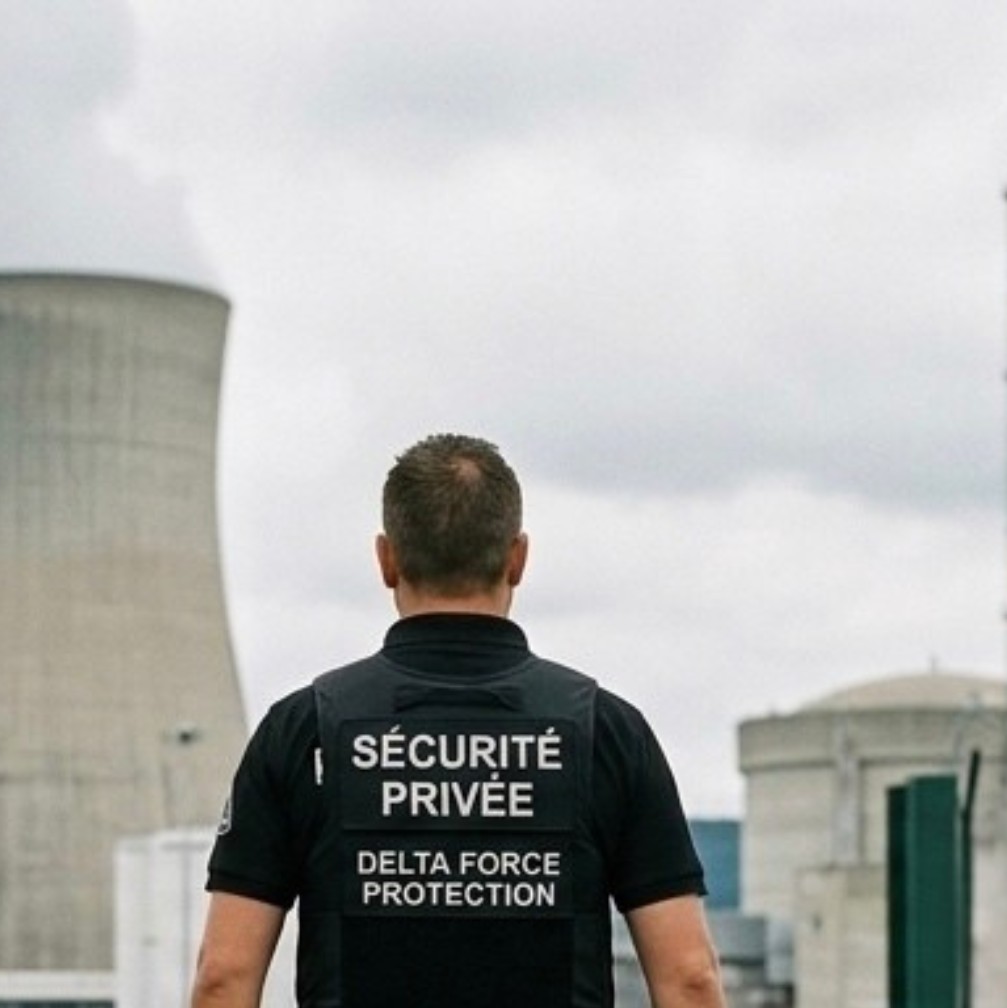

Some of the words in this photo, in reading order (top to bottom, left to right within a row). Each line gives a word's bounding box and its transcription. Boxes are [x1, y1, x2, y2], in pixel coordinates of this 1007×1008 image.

[351, 724, 563, 770] SÉCURITÉ
[382, 771, 534, 817] PRIVÉE
[358, 850, 451, 875] DELTA
[460, 851, 561, 876] FORCE
[363, 881, 555, 907] PROTECTION
